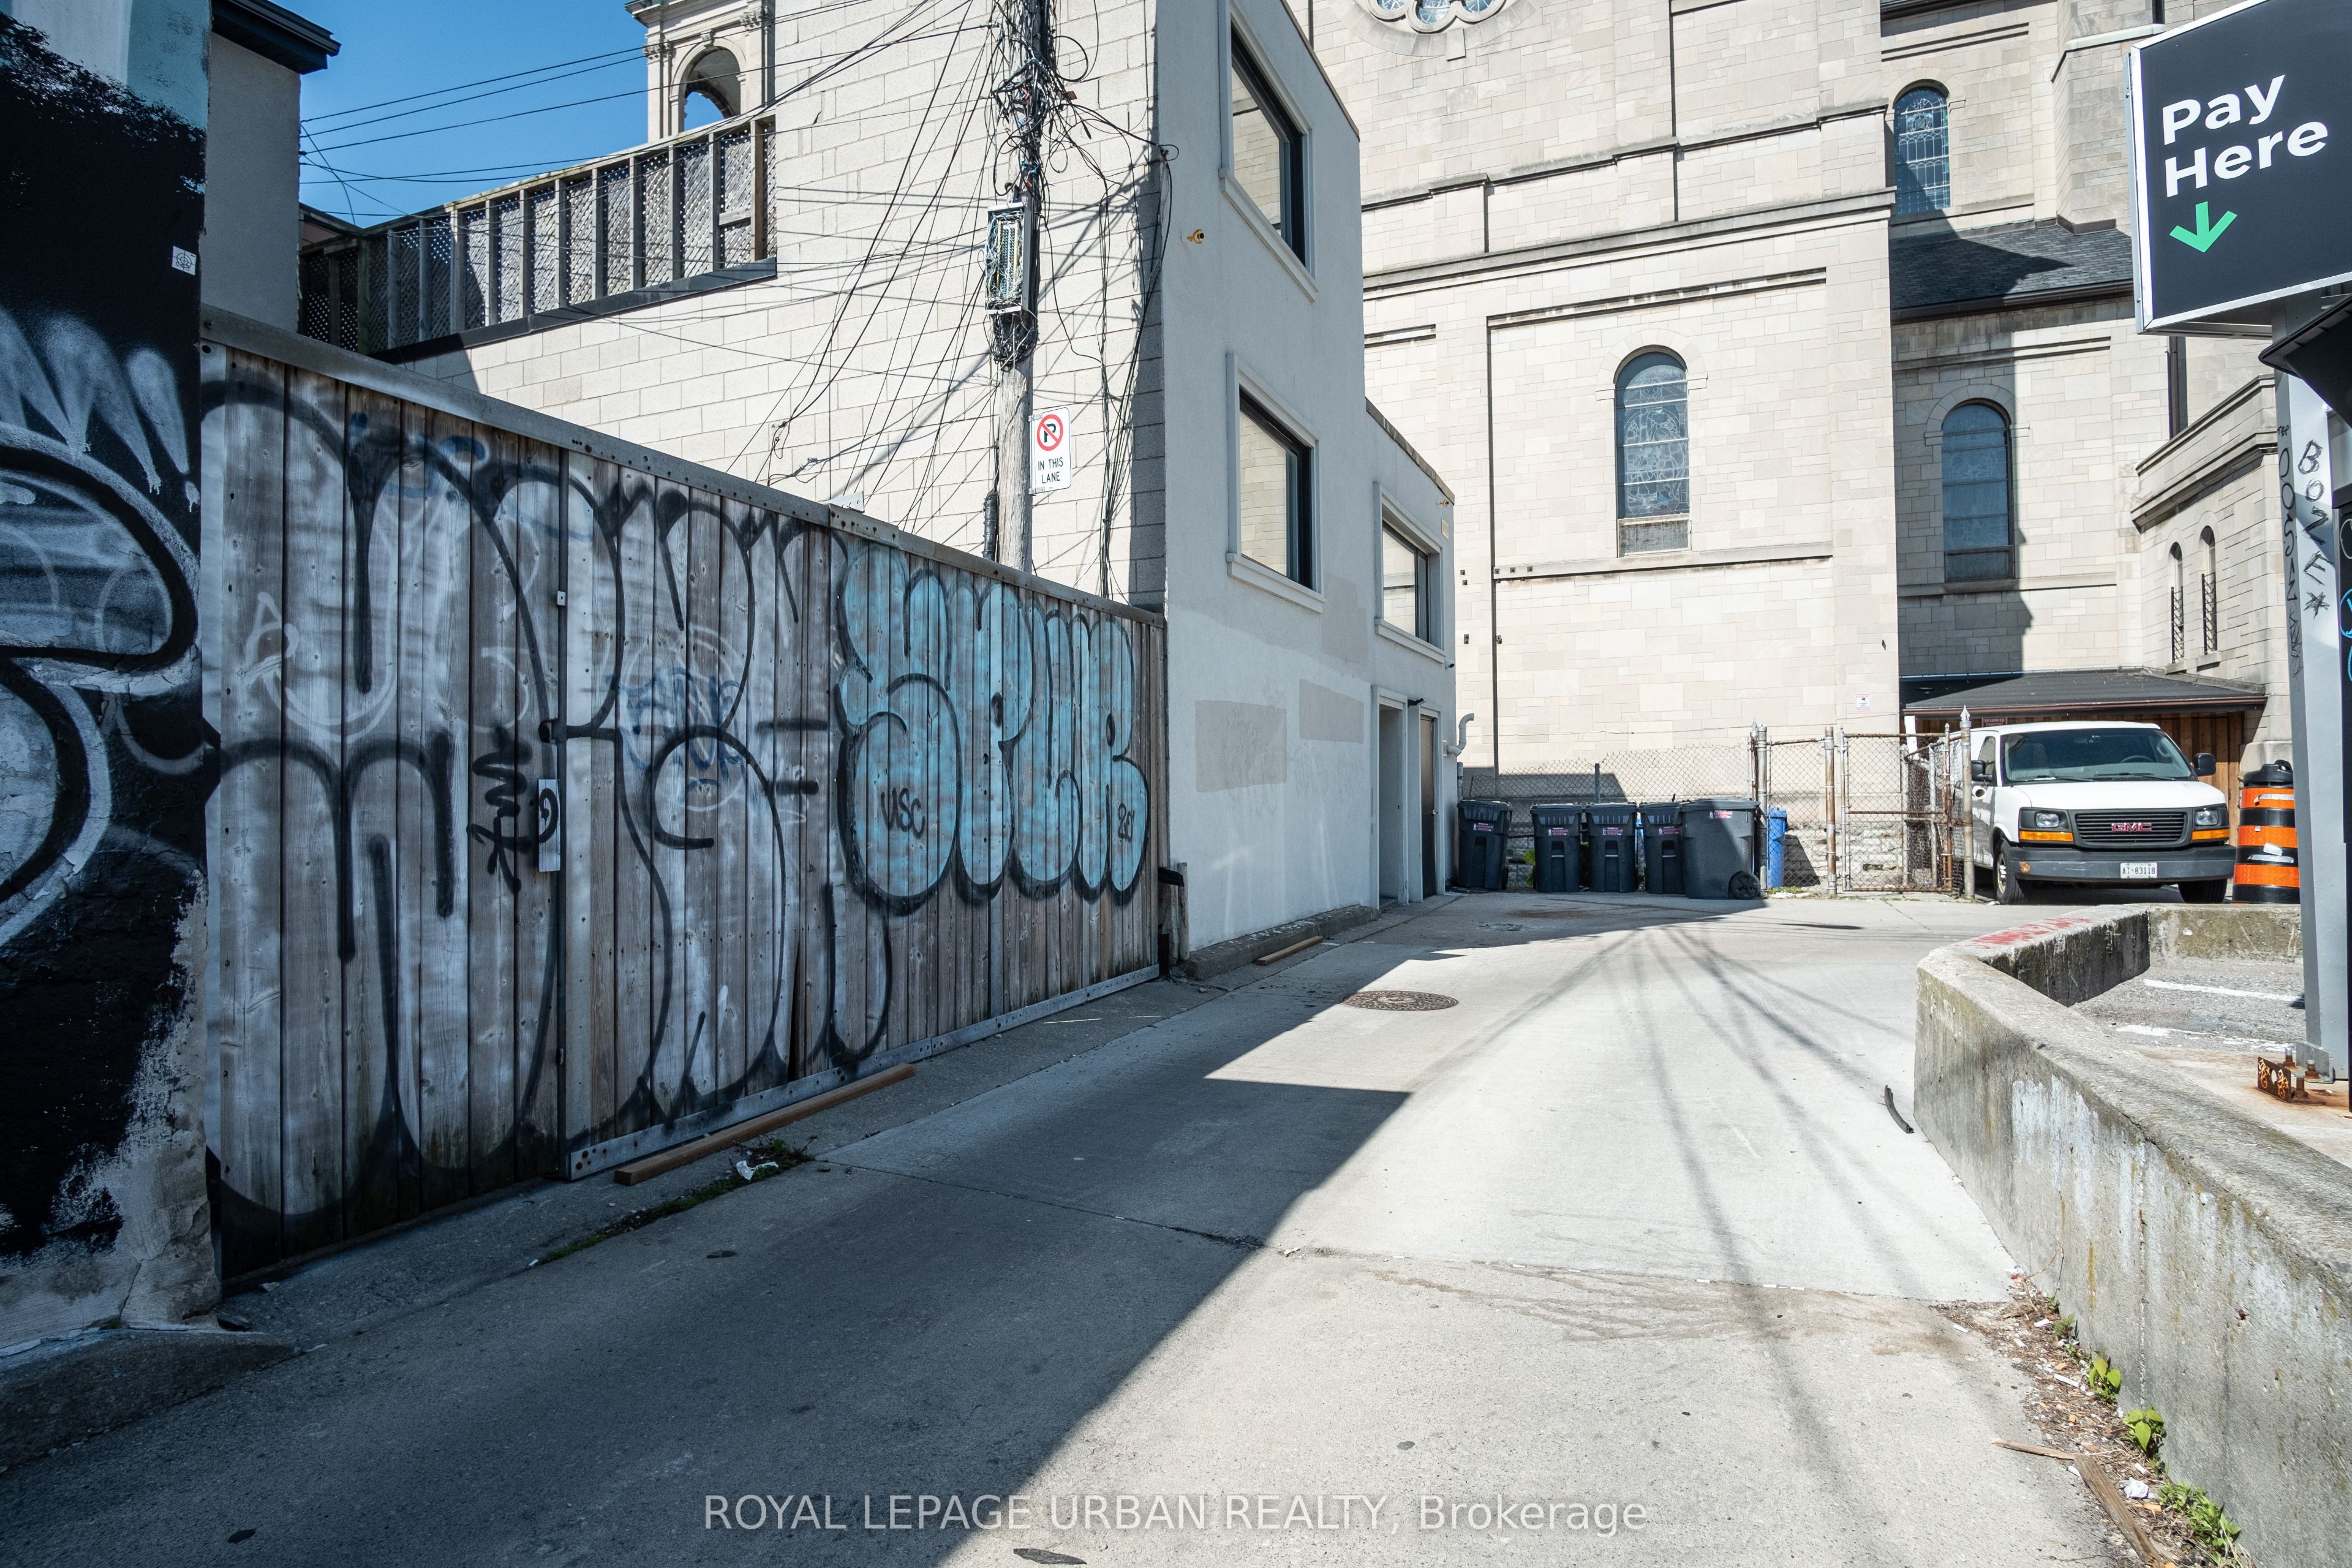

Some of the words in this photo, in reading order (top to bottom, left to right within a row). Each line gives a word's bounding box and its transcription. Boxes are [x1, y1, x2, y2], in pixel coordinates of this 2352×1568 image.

[2163, 74, 2286, 146] Pay
[2165, 121, 2329, 198] Here
[1038, 461, 1044, 470] IN
[1049, 457, 1063, 469] THIS
[1042, 472, 1060, 484] LANE
[2111, 822, 2152, 832] GMC
